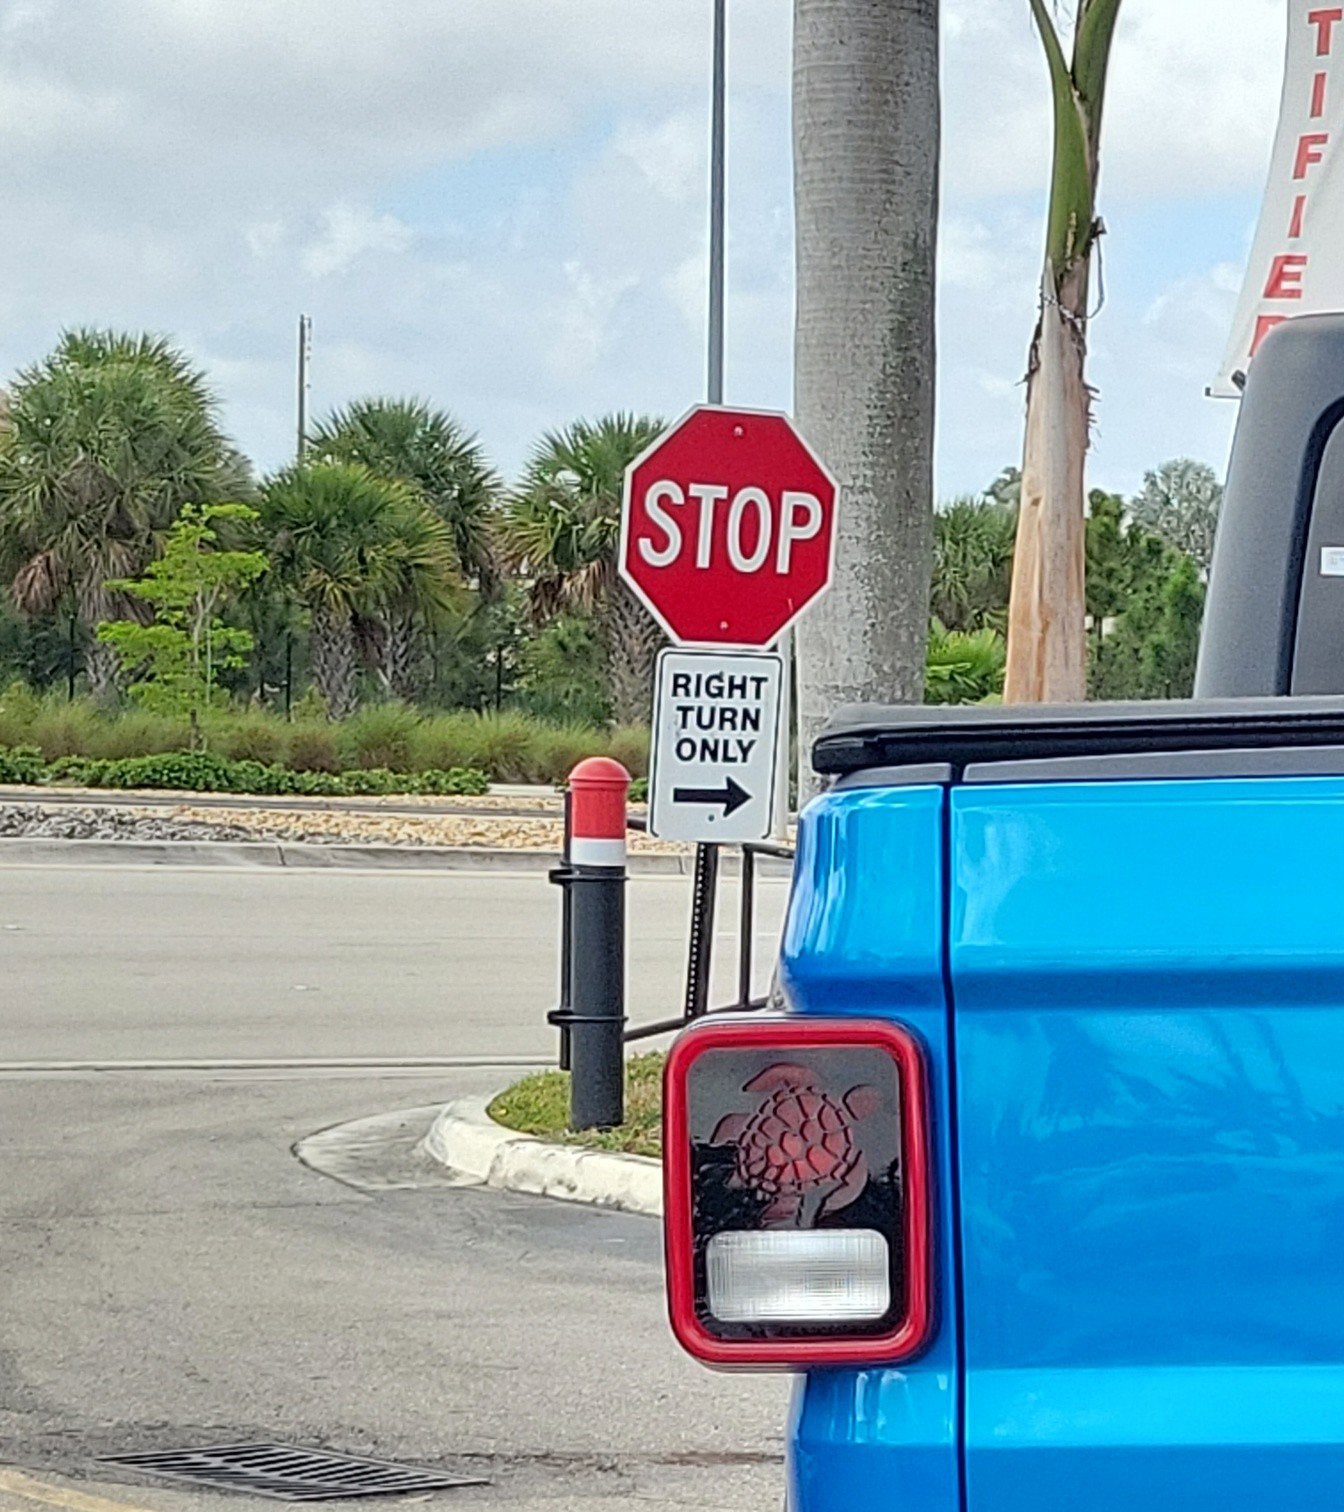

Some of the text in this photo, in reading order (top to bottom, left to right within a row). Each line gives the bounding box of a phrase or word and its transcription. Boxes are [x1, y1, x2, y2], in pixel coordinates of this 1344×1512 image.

[638, 479, 823, 575] STOP
[671, 673, 768, 701] RIGHT
[675, 705, 761, 732] TURN
[675, 737, 756, 764] ONLY
